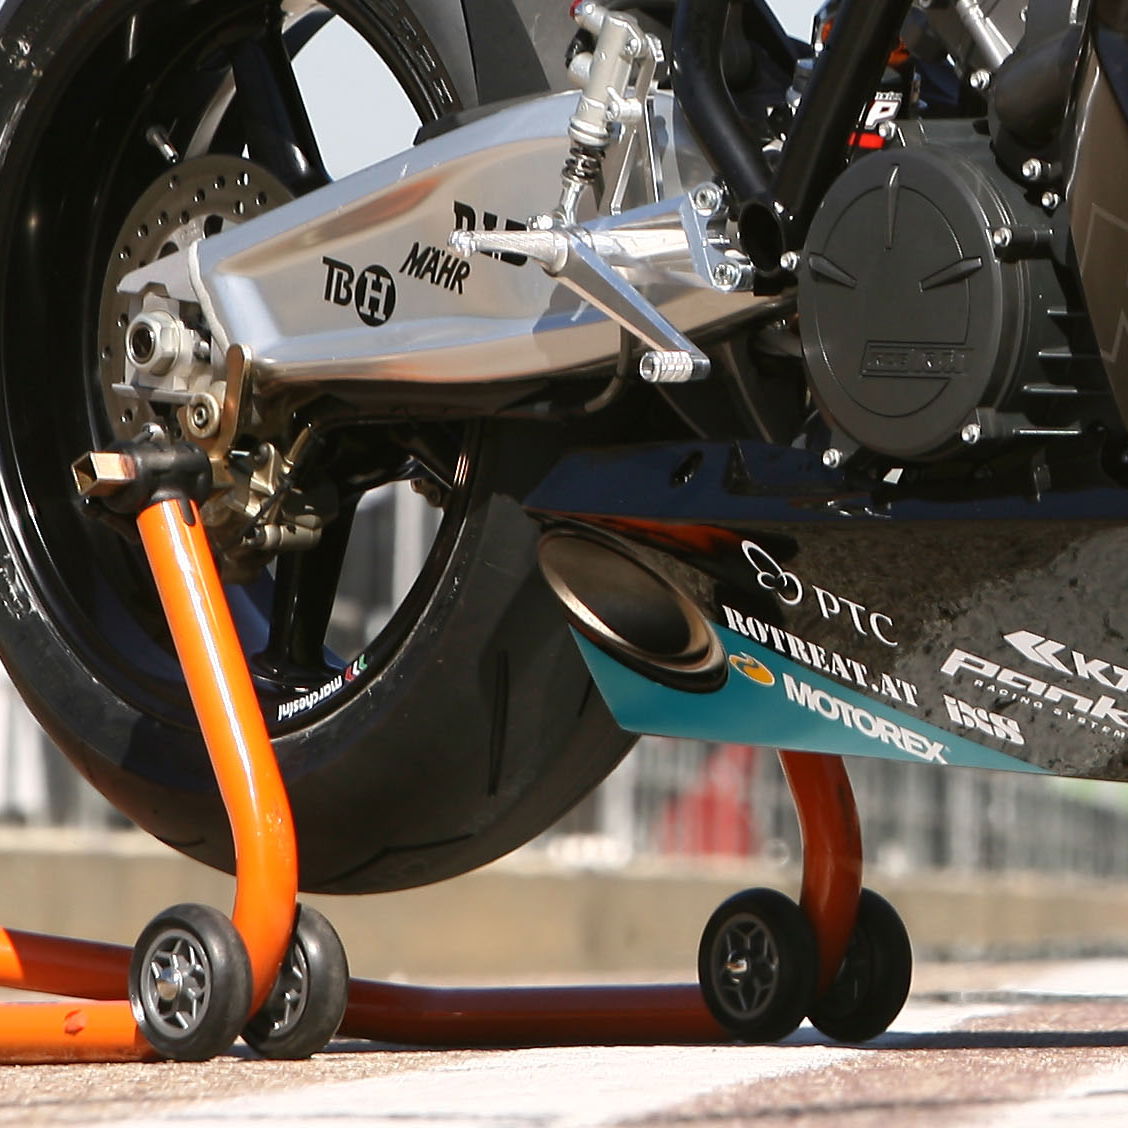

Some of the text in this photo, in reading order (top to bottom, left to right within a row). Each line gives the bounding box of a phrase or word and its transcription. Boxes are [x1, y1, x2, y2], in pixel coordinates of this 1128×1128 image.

[399, 241, 471, 295] MÄHR
[811, 584, 899, 647] PTC
[722, 605, 919, 708] ROTREAT.AT
[278, 675, 343, 721] marchesini
[782, 673, 949, 765] MOTOREX
[973, 679, 1044, 709] RACING
